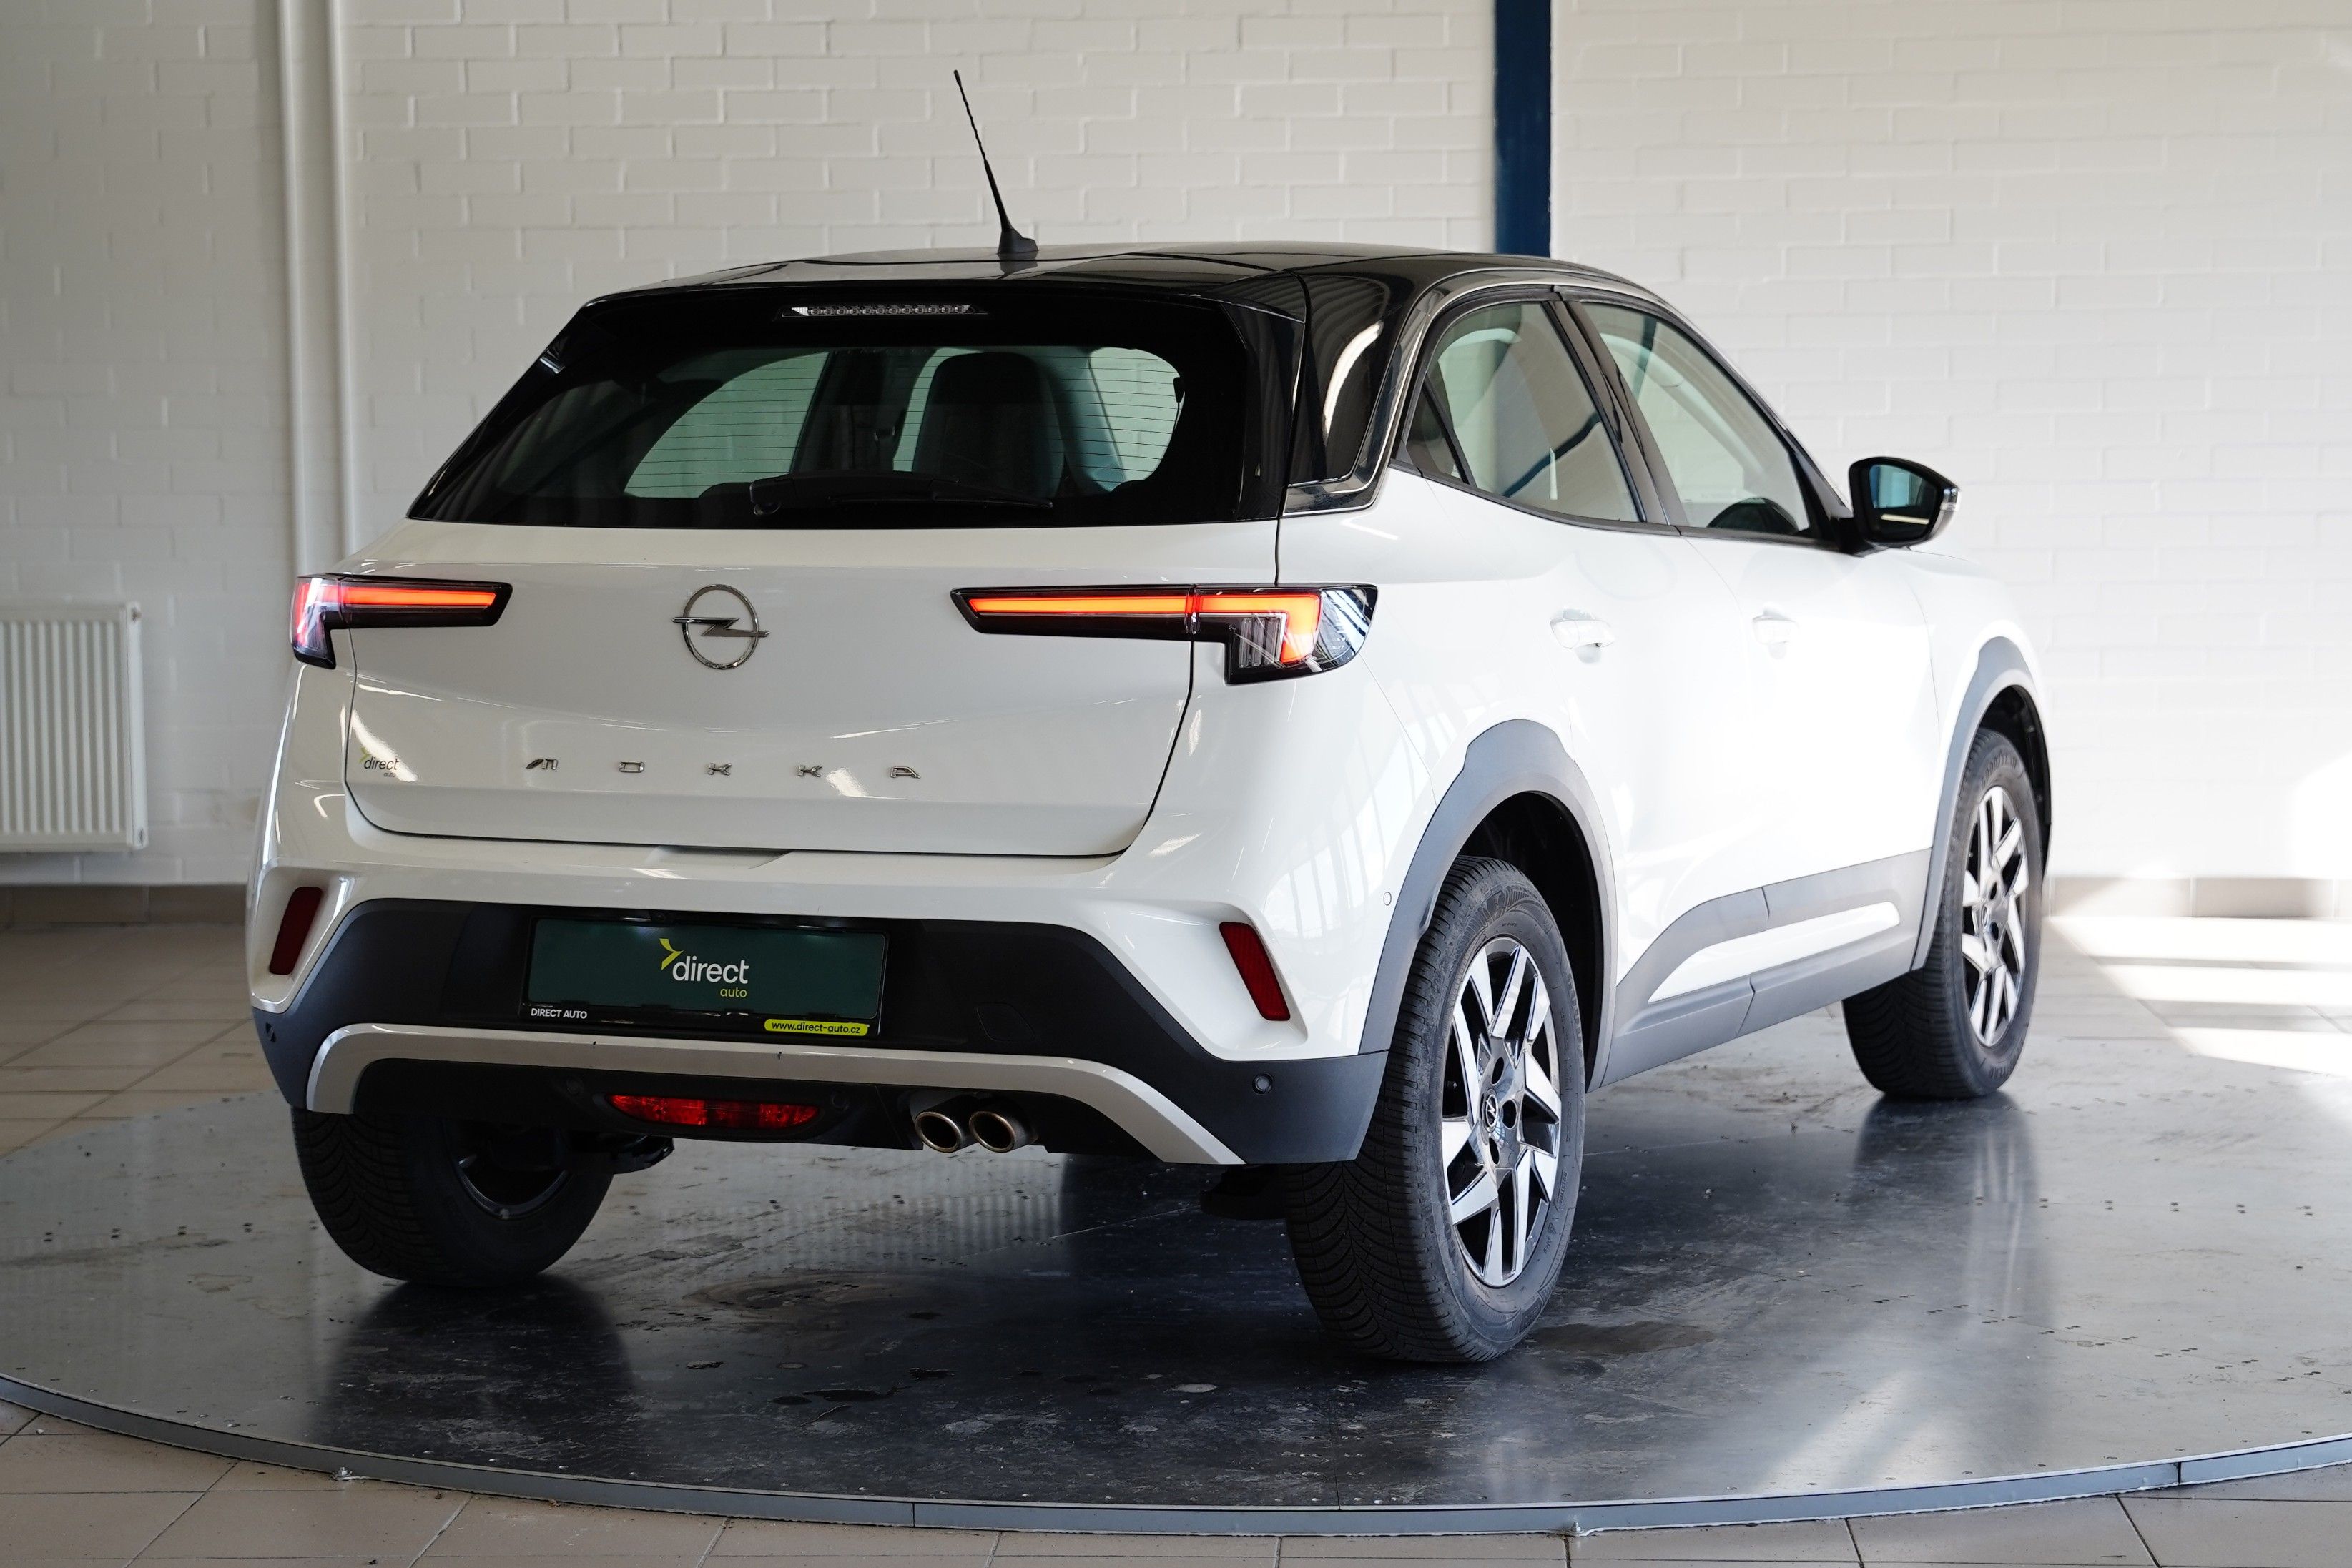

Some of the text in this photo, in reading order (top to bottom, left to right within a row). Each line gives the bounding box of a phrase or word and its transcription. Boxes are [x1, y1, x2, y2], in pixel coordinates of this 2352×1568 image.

[363, 756, 399, 770] direct
[672, 955, 749, 985] direct
[720, 987, 747, 998] auto
[531, 1007, 588, 1020] DIRECT AUTO
[772, 1022, 860, 1034] www.direct-auto.cz
